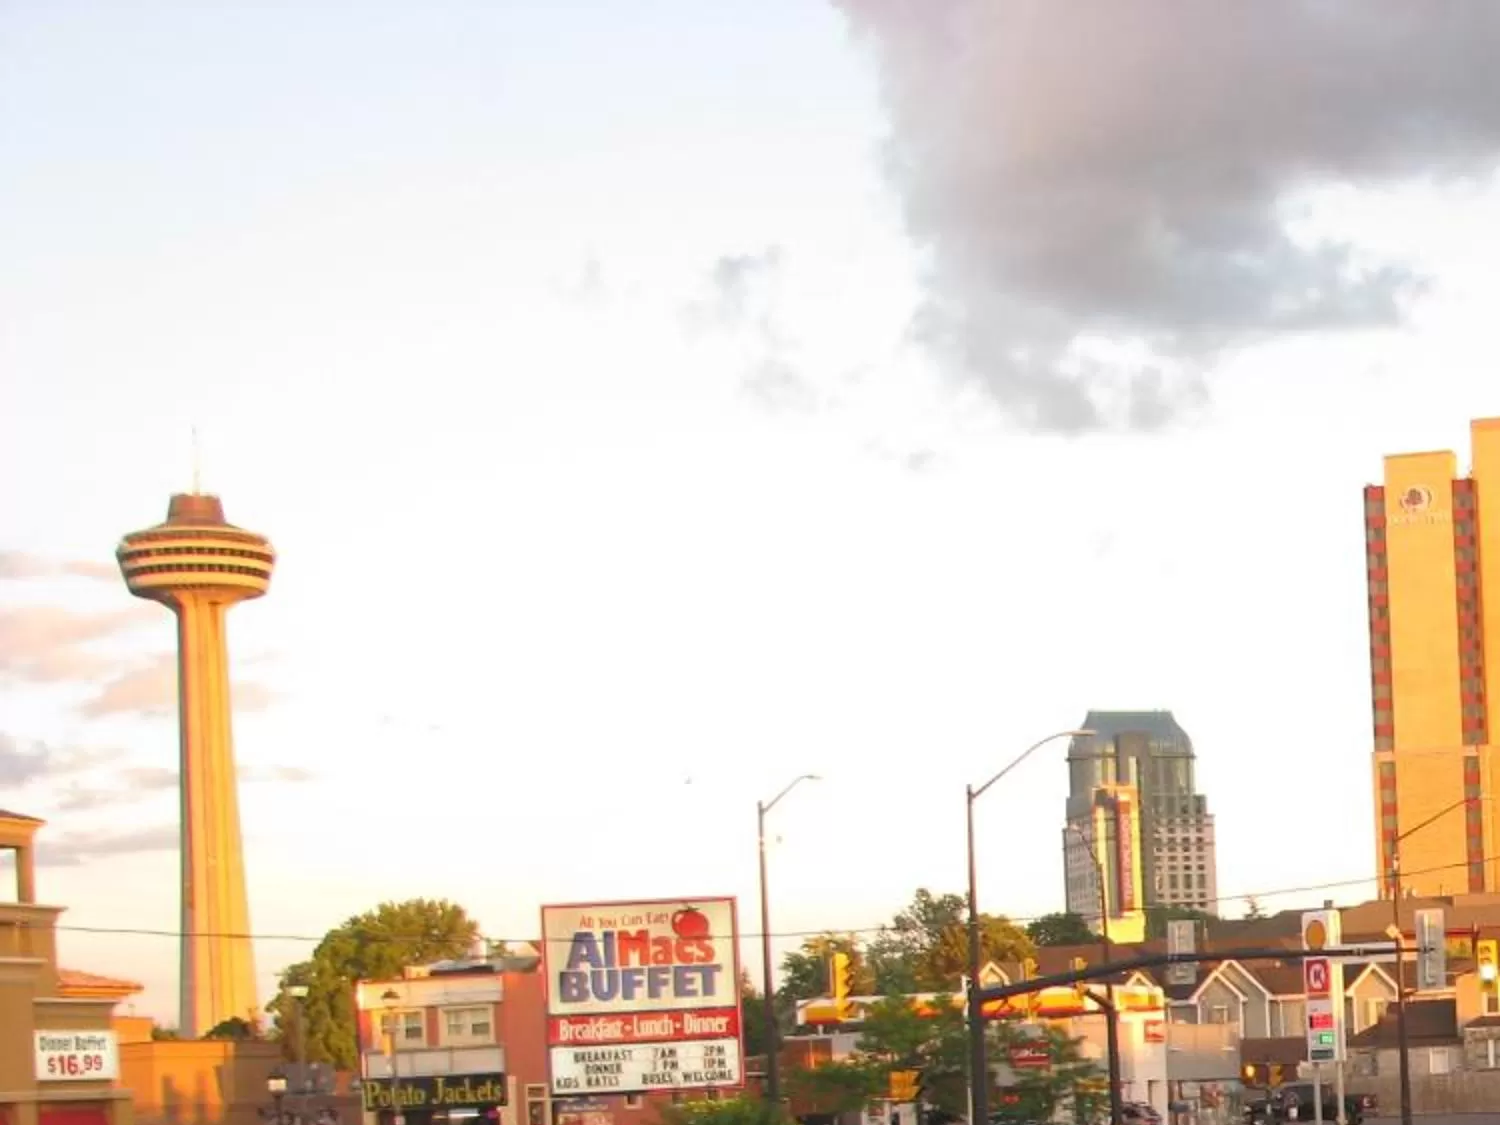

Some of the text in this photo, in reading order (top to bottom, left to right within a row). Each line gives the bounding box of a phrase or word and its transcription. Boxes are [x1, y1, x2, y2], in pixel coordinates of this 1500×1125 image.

[559, 964, 723, 1003] BUFFET
[559, 1011, 730, 1042] Breakfast Lunch Dinner
[47, 1053, 104, 1076] $16.99
[574, 1049, 633, 1064] BREAKFAST
[682, 1068, 733, 1083] WELCOME
[364, 1076, 502, 1108] Potato Jackets
